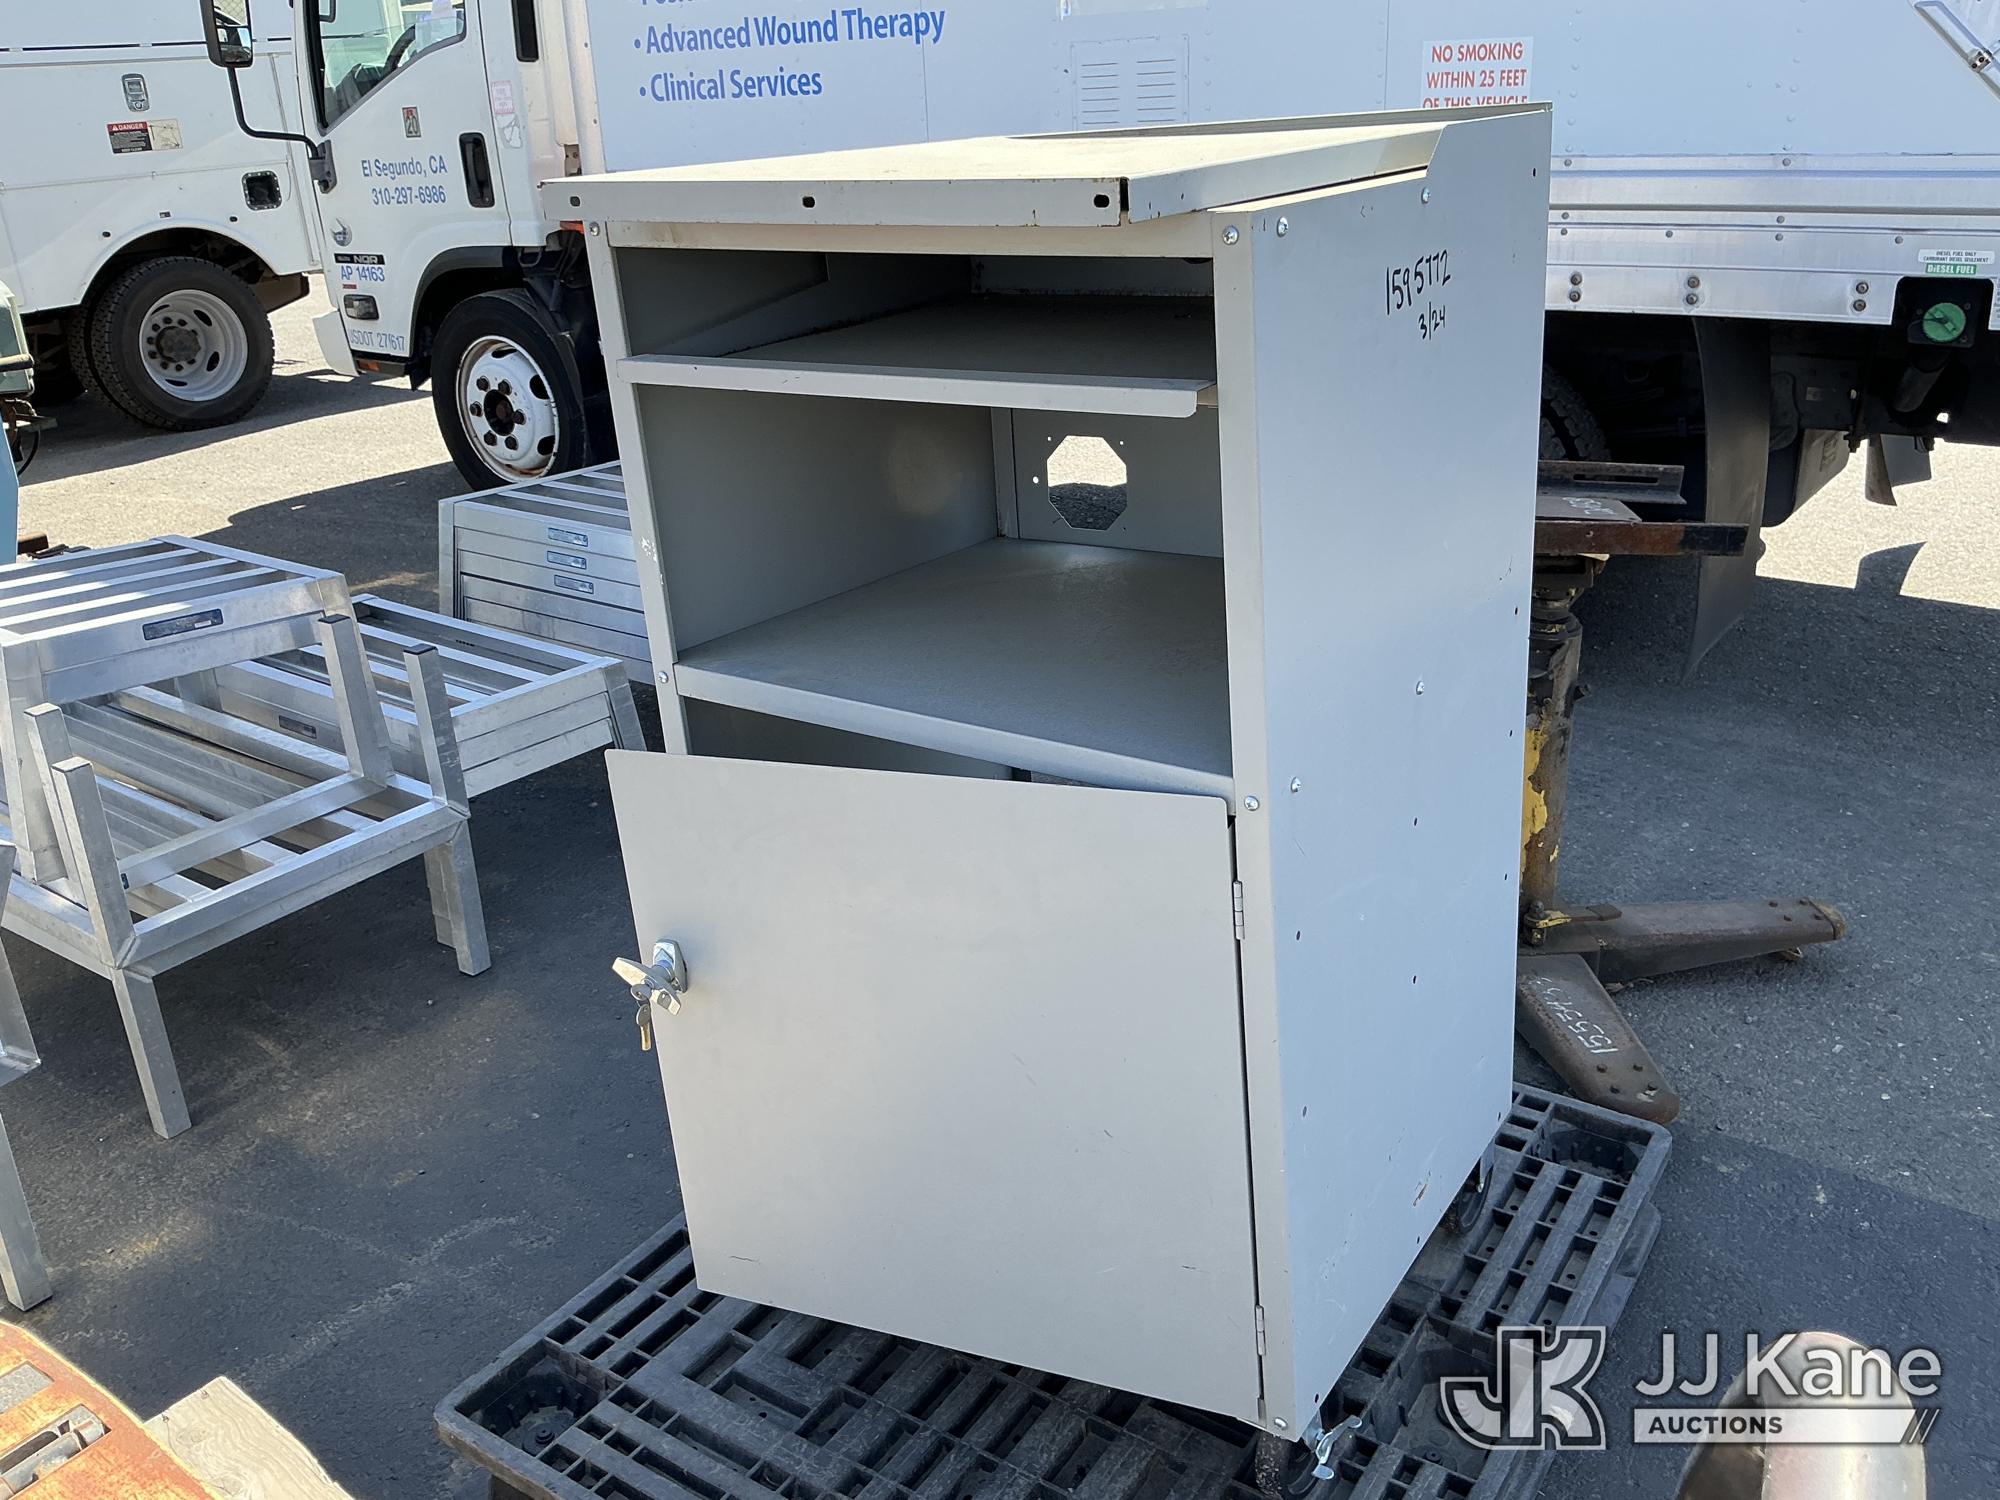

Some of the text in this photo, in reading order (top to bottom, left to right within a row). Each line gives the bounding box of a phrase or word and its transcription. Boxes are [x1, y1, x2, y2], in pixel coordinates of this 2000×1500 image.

[646, 8, 945, 53] Advanced Wound Therapy
[1432, 42, 1524, 63] NO SMOKING
[650, 66, 823, 102] Clinical Services
[1426, 69, 1527, 88] WITHIN 25 FEET
[118, 123, 144, 131] DANGER
[361, 155, 448, 181] El Segundo, CA
[371, 185, 446, 205] 310-297-6986
[341, 266, 385, 282] AP 14163
[1955, 265, 1975, 274] FUEL
[1386, 249, 1451, 316] 1595772
